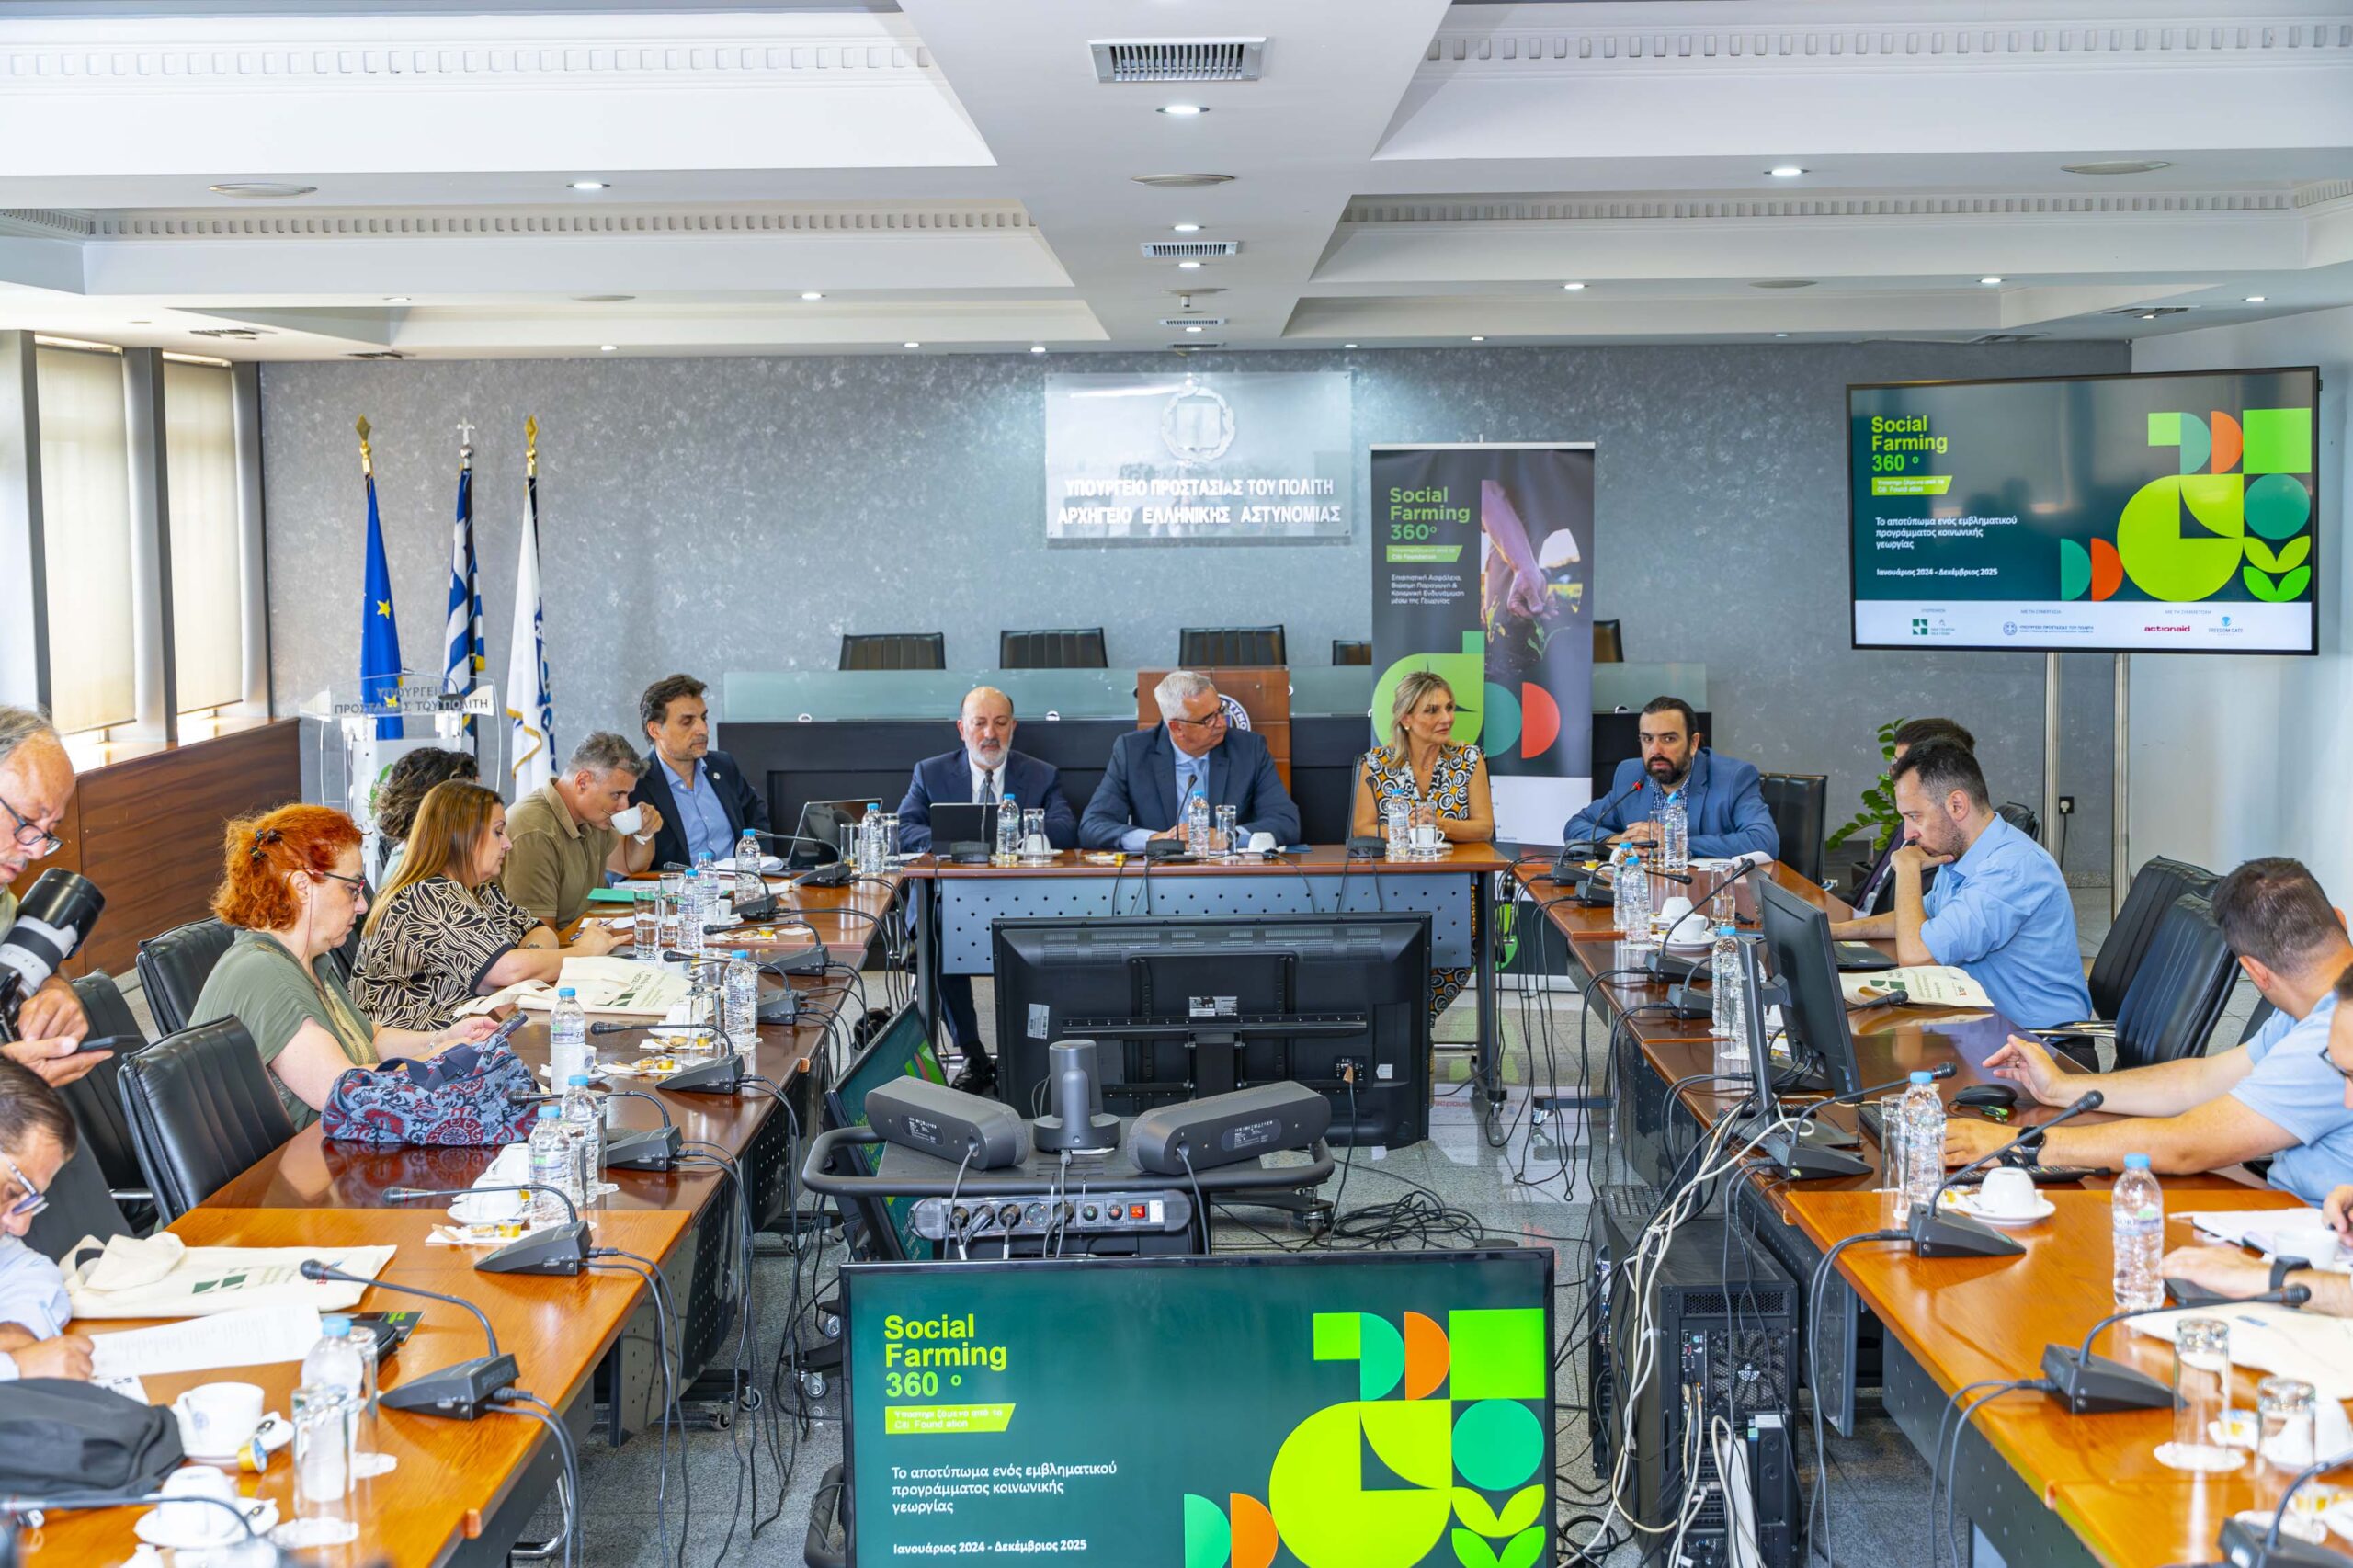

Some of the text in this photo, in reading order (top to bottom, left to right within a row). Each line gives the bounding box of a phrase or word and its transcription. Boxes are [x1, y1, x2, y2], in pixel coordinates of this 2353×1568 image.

[1871, 415, 1927, 433] Social
[1871, 434, 1948, 454] Farming
[1872, 454, 1905, 472] 360
[1064, 479, 1334, 496] ΥΠΟΥΡΓΕΙΟ ΠΡΟΣΤΑΣΙΑΣ ΤΟΥ ΠΟΛΙΤΗ
[1390, 486, 1448, 503] Social
[1057, 506, 1341, 524] ΑΡΧΗΓΕΙΟ ΕΛΛΗΝΙΚΗΣ ΑΣΤΥΝΟΜΙΑΣ
[1390, 505, 1471, 523] Farming
[1875, 517, 1886, 526] Το
[1887, 517, 1936, 527] αποτύπωμα
[1958, 516, 2018, 527] εμβληματικού
[1875, 528, 1984, 538] προγράμματος κοινωνικής
[1876, 540, 1914, 550] γεωργίας
[1877, 568, 1915, 577] Ιανουάριος
[1916, 568, 1934, 576] 2024
[1980, 568, 1997, 576] 2025
[416, 699, 438, 712] ΤΟΥ
[884, 1313, 974, 1340] Social
[885, 1342, 1007, 1371] Farming
[885, 1372, 939, 1397] 360
[892, 1460, 1118, 1481] Το αποτύπωμα ενός εμβληματικού
[892, 1480, 1064, 1498] προγράμματος κοινωνικής
[892, 1499, 953, 1515] γεωργίας
[893, 1541, 957, 1554] Ιανουάριος
[959, 1541, 985, 1552] 2024
[994, 1540, 1058, 1554] Δεκέμβριος
[1061, 1540, 1086, 1551] 2025
